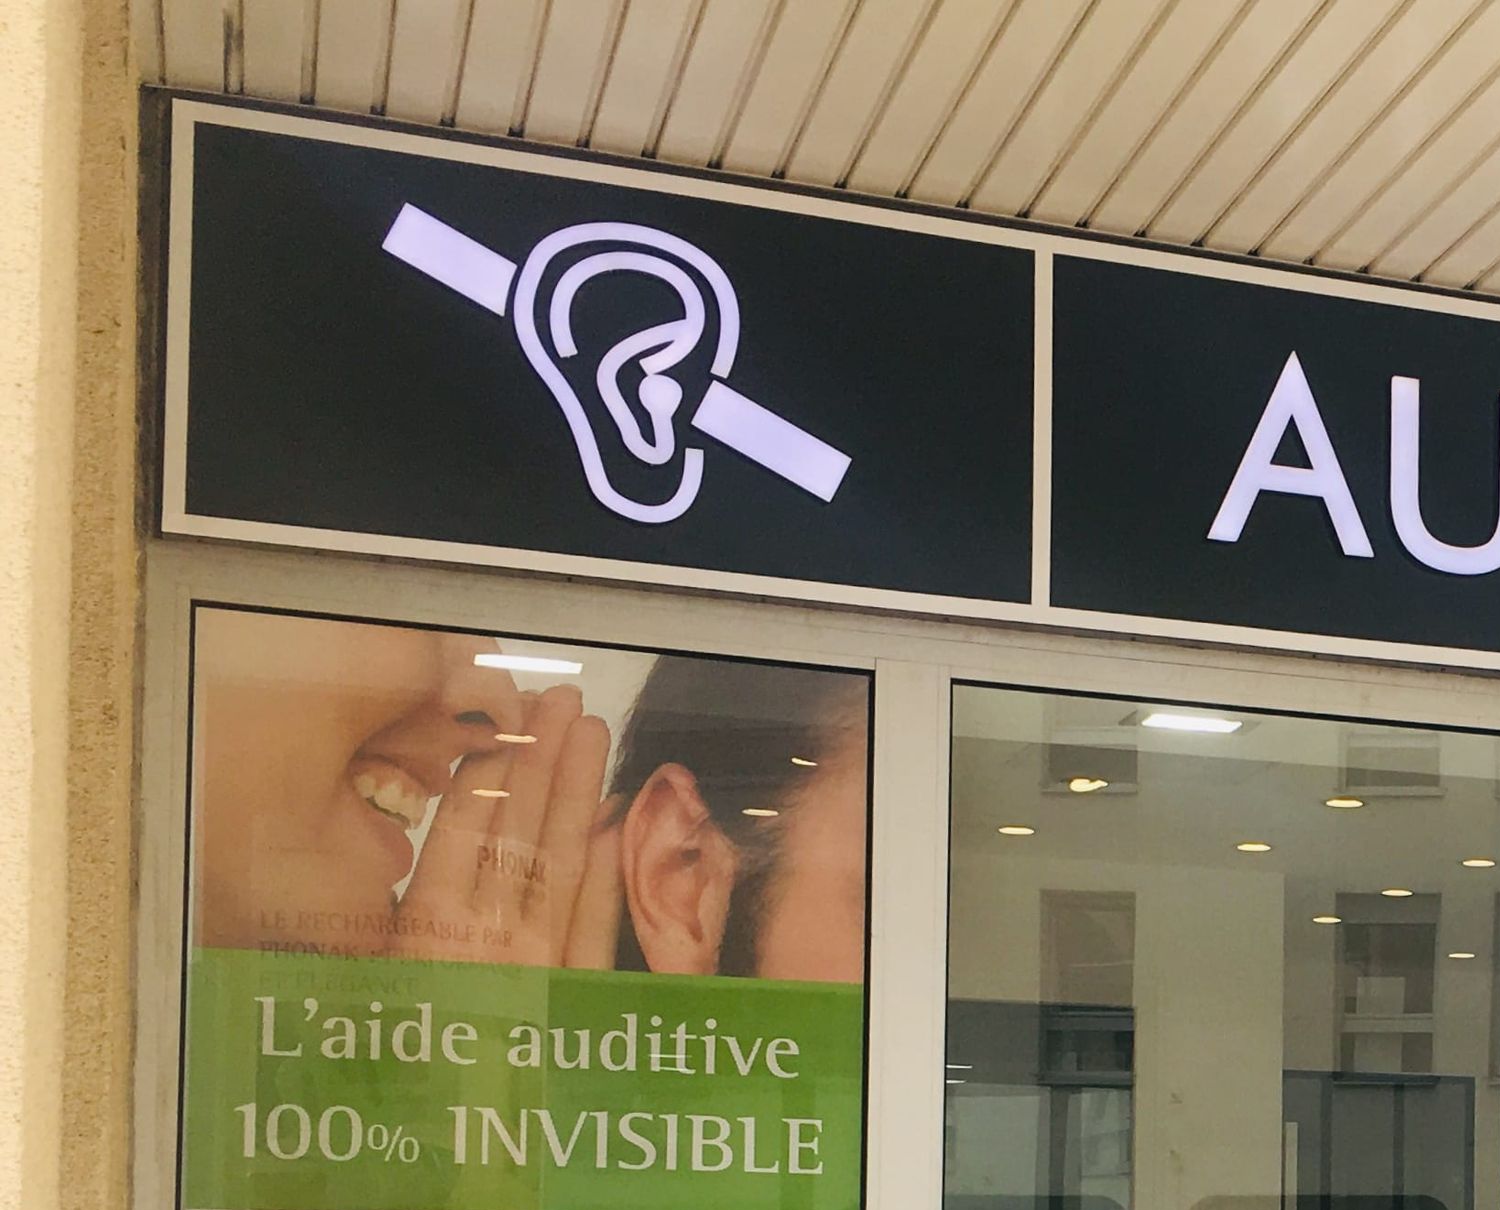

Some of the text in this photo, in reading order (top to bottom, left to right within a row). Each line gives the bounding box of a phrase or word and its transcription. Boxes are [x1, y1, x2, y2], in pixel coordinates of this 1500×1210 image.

[254, 996, 800, 1078] L'aide auditive
[234, 1102, 824, 1175] 100% INVISIBLE
